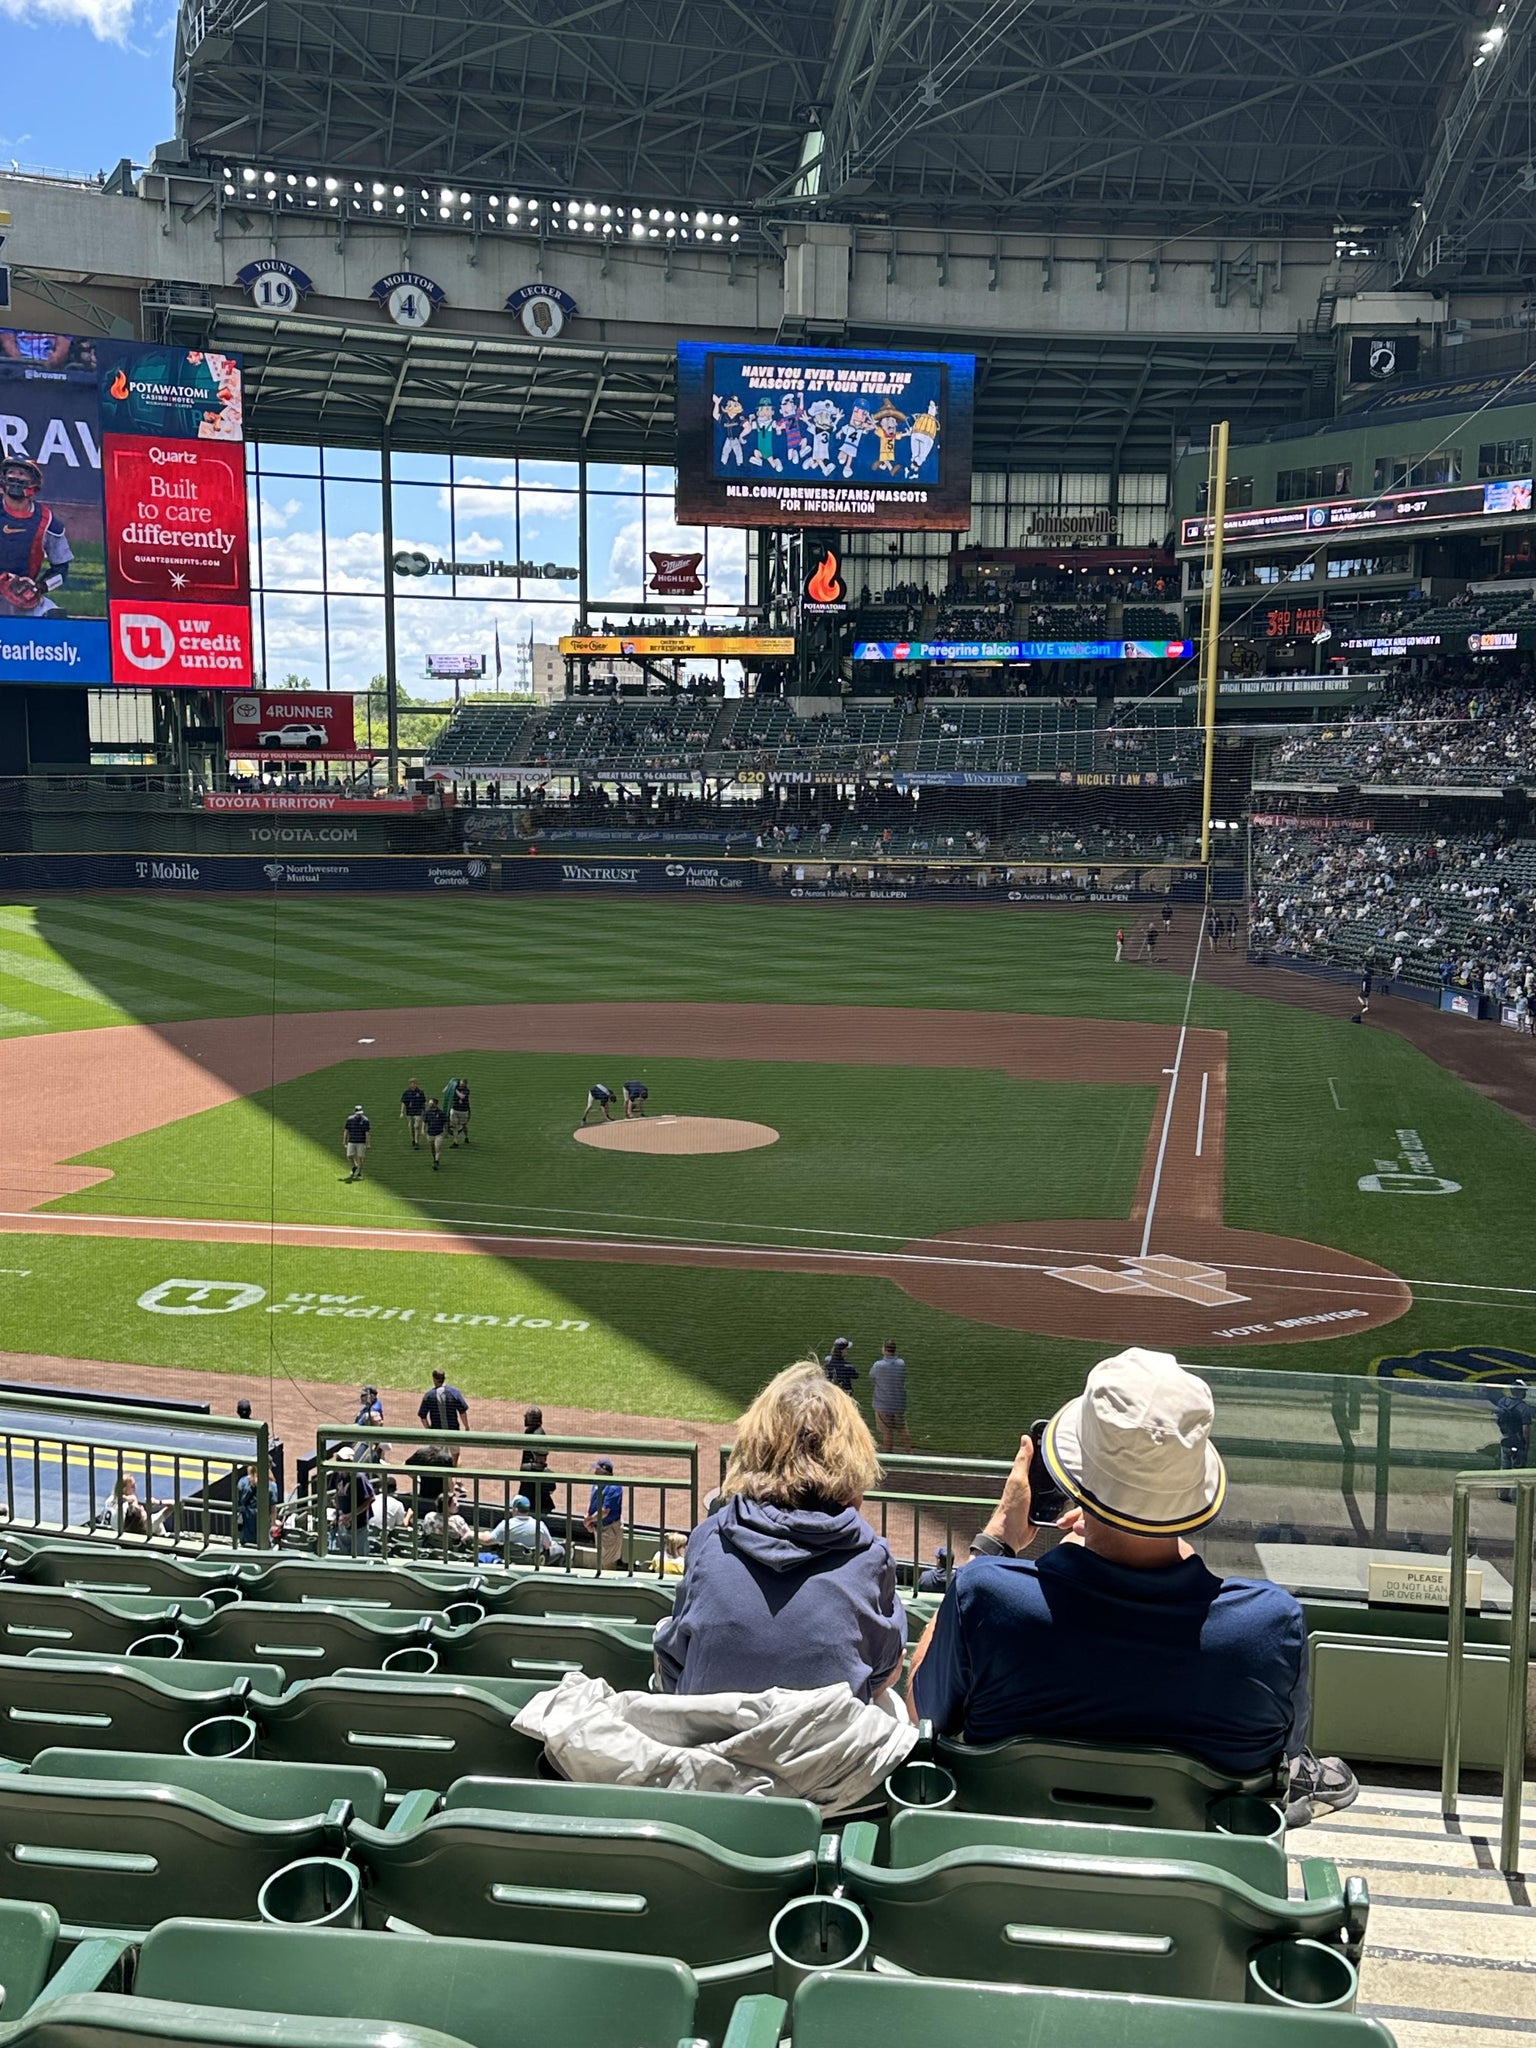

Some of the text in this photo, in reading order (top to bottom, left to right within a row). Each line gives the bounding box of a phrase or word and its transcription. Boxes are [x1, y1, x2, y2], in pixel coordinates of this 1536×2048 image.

[254, 260, 295, 276] YOUNT
[383, 275, 435, 293] MOLITOR
[259, 280, 292, 307] 19
[520, 285, 562, 301] UECKER
[400, 294, 416, 319] 4
[742, 366, 912, 384] HAVE YOU EVER WANTED THE
[129, 381, 209, 399] POTAWATOMI
[749, 377, 905, 395] MASCOTS AT YOUR EVENT?
[141, 393, 169, 402] CASINO
[172, 395, 195, 405] HOTEL
[820, 433, 829, 444] 3
[849, 431, 858, 442] 4
[887, 439, 895, 450] 5
[148, 447, 198, 465] Quartz
[149, 476, 198, 501] Built
[726, 485, 928, 503] MLB.COM/BREWERS/FANS/MASCOTS
[138, 501, 212, 523] to care
[780, 499, 875, 513] FOR INFORMATION
[1026, 510, 1118, 535] Johnsonville
[1238, 518, 1264, 528] LEAGUE
[1265, 513, 1305, 525] STANDINGS
[122, 523, 236, 554] differently
[134, 555, 221, 567] QUARTZBENEFITS.COM
[661, 560, 692, 574] Miller
[435, 558, 578, 580] Aurora Health Care
[1296, 608, 1326, 619] MARKET
[178, 618, 211, 633] uw
[179, 634, 241, 652] credit
[920, 644, 979, 658] Peregrine
[981, 643, 1020, 656] falcon
[1022, 643, 1053, 655] LIVE
[1058, 643, 1111, 656] webcam
[180, 652, 244, 669] union
[1260, 682, 1275, 692] PIZZA
[1275, 682, 1283, 692] OF
[265, 705, 334, 719] 4RUNNER
[228, 751, 260, 759] COURTESY
[322, 752, 345, 760] TOYOTA
[597, 771, 620, 781] GREAT
[643, 772, 653, 781] 96
[738, 771, 812, 784] 620 WTMJ
[963, 773, 1019, 785] WINTRUST
[1076, 774, 1141, 786] NICOLET LAW
[208, 797, 336, 809] TOYOTA TERRITORY
[250, 828, 358, 841] TOYOTA.COM
[151, 862, 200, 880] Mobile
[286, 864, 349, 873] Northwestern
[428, 868, 462, 877] Johnson
[562, 865, 638, 879] WINTRUST
[686, 867, 719, 877] Aurora
[286, 873, 320, 882] Mutual
[434, 876, 469, 885] Controls
[686, 877, 743, 887] Health Care
[870, 890, 907, 899] BULLPEN
[1090, 894, 1129, 902] BULLPEN
[264, 1303, 591, 1332] credit union
[1212, 1308, 1369, 1339] VOTE BREWERS
[1407, 1572, 1444, 1584] PLEASE
[1386, 1581, 1448, 1593] DO NOT LEAN
[1397, 1590, 1423, 1600] OVER
